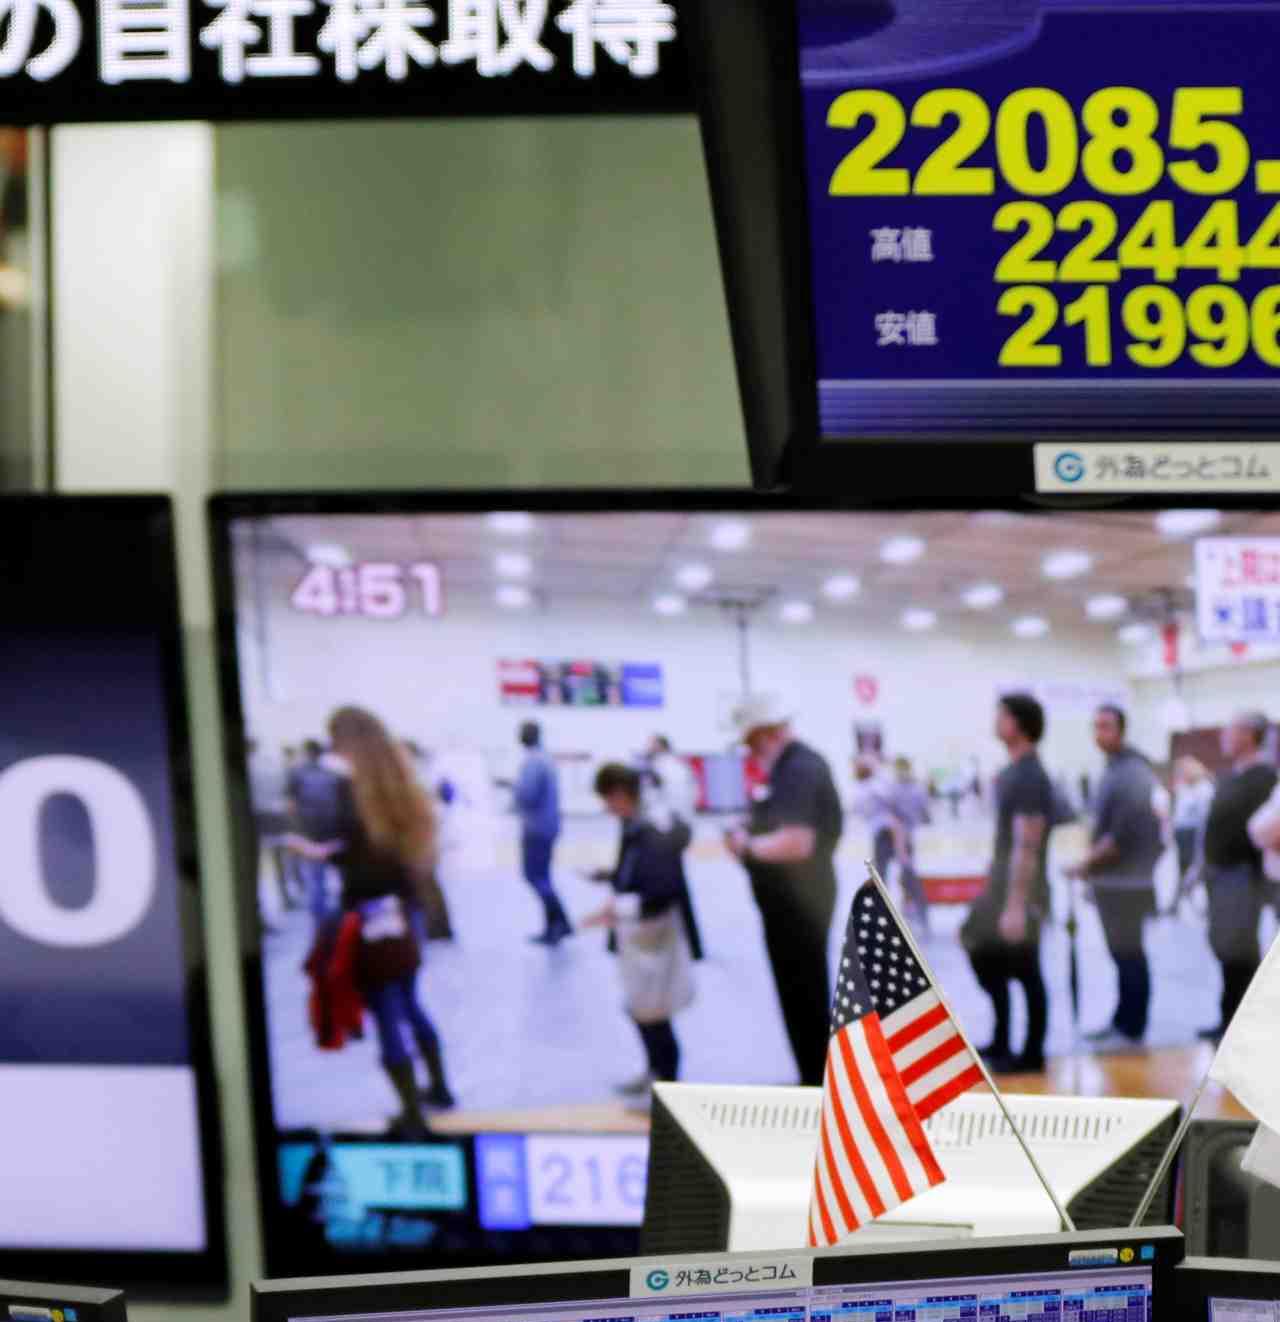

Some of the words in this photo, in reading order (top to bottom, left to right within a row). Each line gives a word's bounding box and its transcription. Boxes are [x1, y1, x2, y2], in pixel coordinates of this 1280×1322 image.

[870, 227, 933, 262] 高値
[874, 311, 938, 346] 安値
[1094, 452, 1271, 482] 外為どっとコム
[674, 1262, 797, 1286] 外為どっとコム
